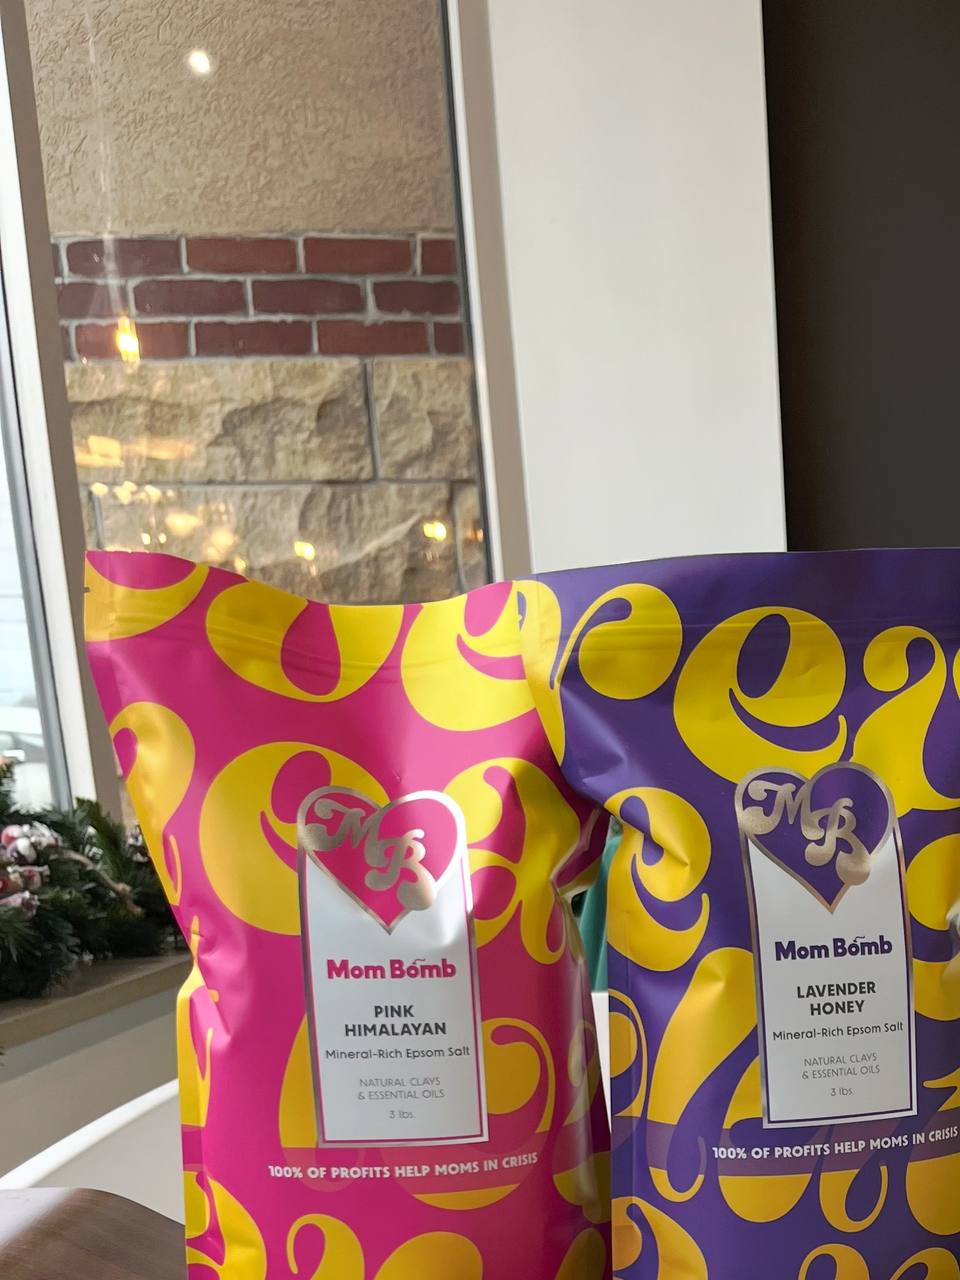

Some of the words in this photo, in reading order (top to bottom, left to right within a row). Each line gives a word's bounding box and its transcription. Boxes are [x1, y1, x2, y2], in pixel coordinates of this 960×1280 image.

[775, 940, 829, 961] Mom
[327, 959, 386, 979] Mom
[797, 981, 876, 999] LAVENDER
[374, 1005, 414, 1018] PINK
[810, 1000, 865, 1016] HONEY
[344, 1022, 447, 1037] HIMALAYAN
[773, 1026, 844, 1041] Mineral-Rich
[846, 1024, 881, 1039] Epsom
[884, 1022, 904, 1033] Salt
[325, 1049, 402, 1060] Mineral-Rich
[406, 1047, 445, 1060] Epsom
[448, 1046, 470, 1057] Salt
[804, 1055, 847, 1067] NATURAL
[850, 1053, 877, 1064] CLAYS
[802, 1070, 809, 1079] &
[812, 1067, 857, 1079] ESSENTIAL
[860, 1065, 880, 1075] OILS
[359, 1077, 406, 1088] NATURAL
[410, 1077, 441, 1086] CLAYS
[358, 1091, 366, 1100] &
[368, 1089, 420, 1100] ESSENTIAL
[422, 1089, 445, 1098] OILS
[830, 1088, 836, 1097] 3
[389, 1110, 396, 1119] 3
[712, 1147, 747, 1159] 100%
[751, 1147, 770, 1159] OF
[774, 1144, 830, 1159] PROFITS
[834, 1141, 866, 1154] HELP
[869, 1135, 908, 1150] MOMS
[912, 1133, 925, 1145] IN
[928, 1126, 958, 1143] CRISIS
[268, 1165, 303, 1178] 100%
[307, 1166, 327, 1179] OF
[331, 1166, 390, 1179] PROFITS
[395, 1165, 430, 1178] HELP
[434, 1162, 480, 1176] MOMS
[484, 1159, 498, 1171] IN
[502, 1152, 538, 1169] CRISIS
